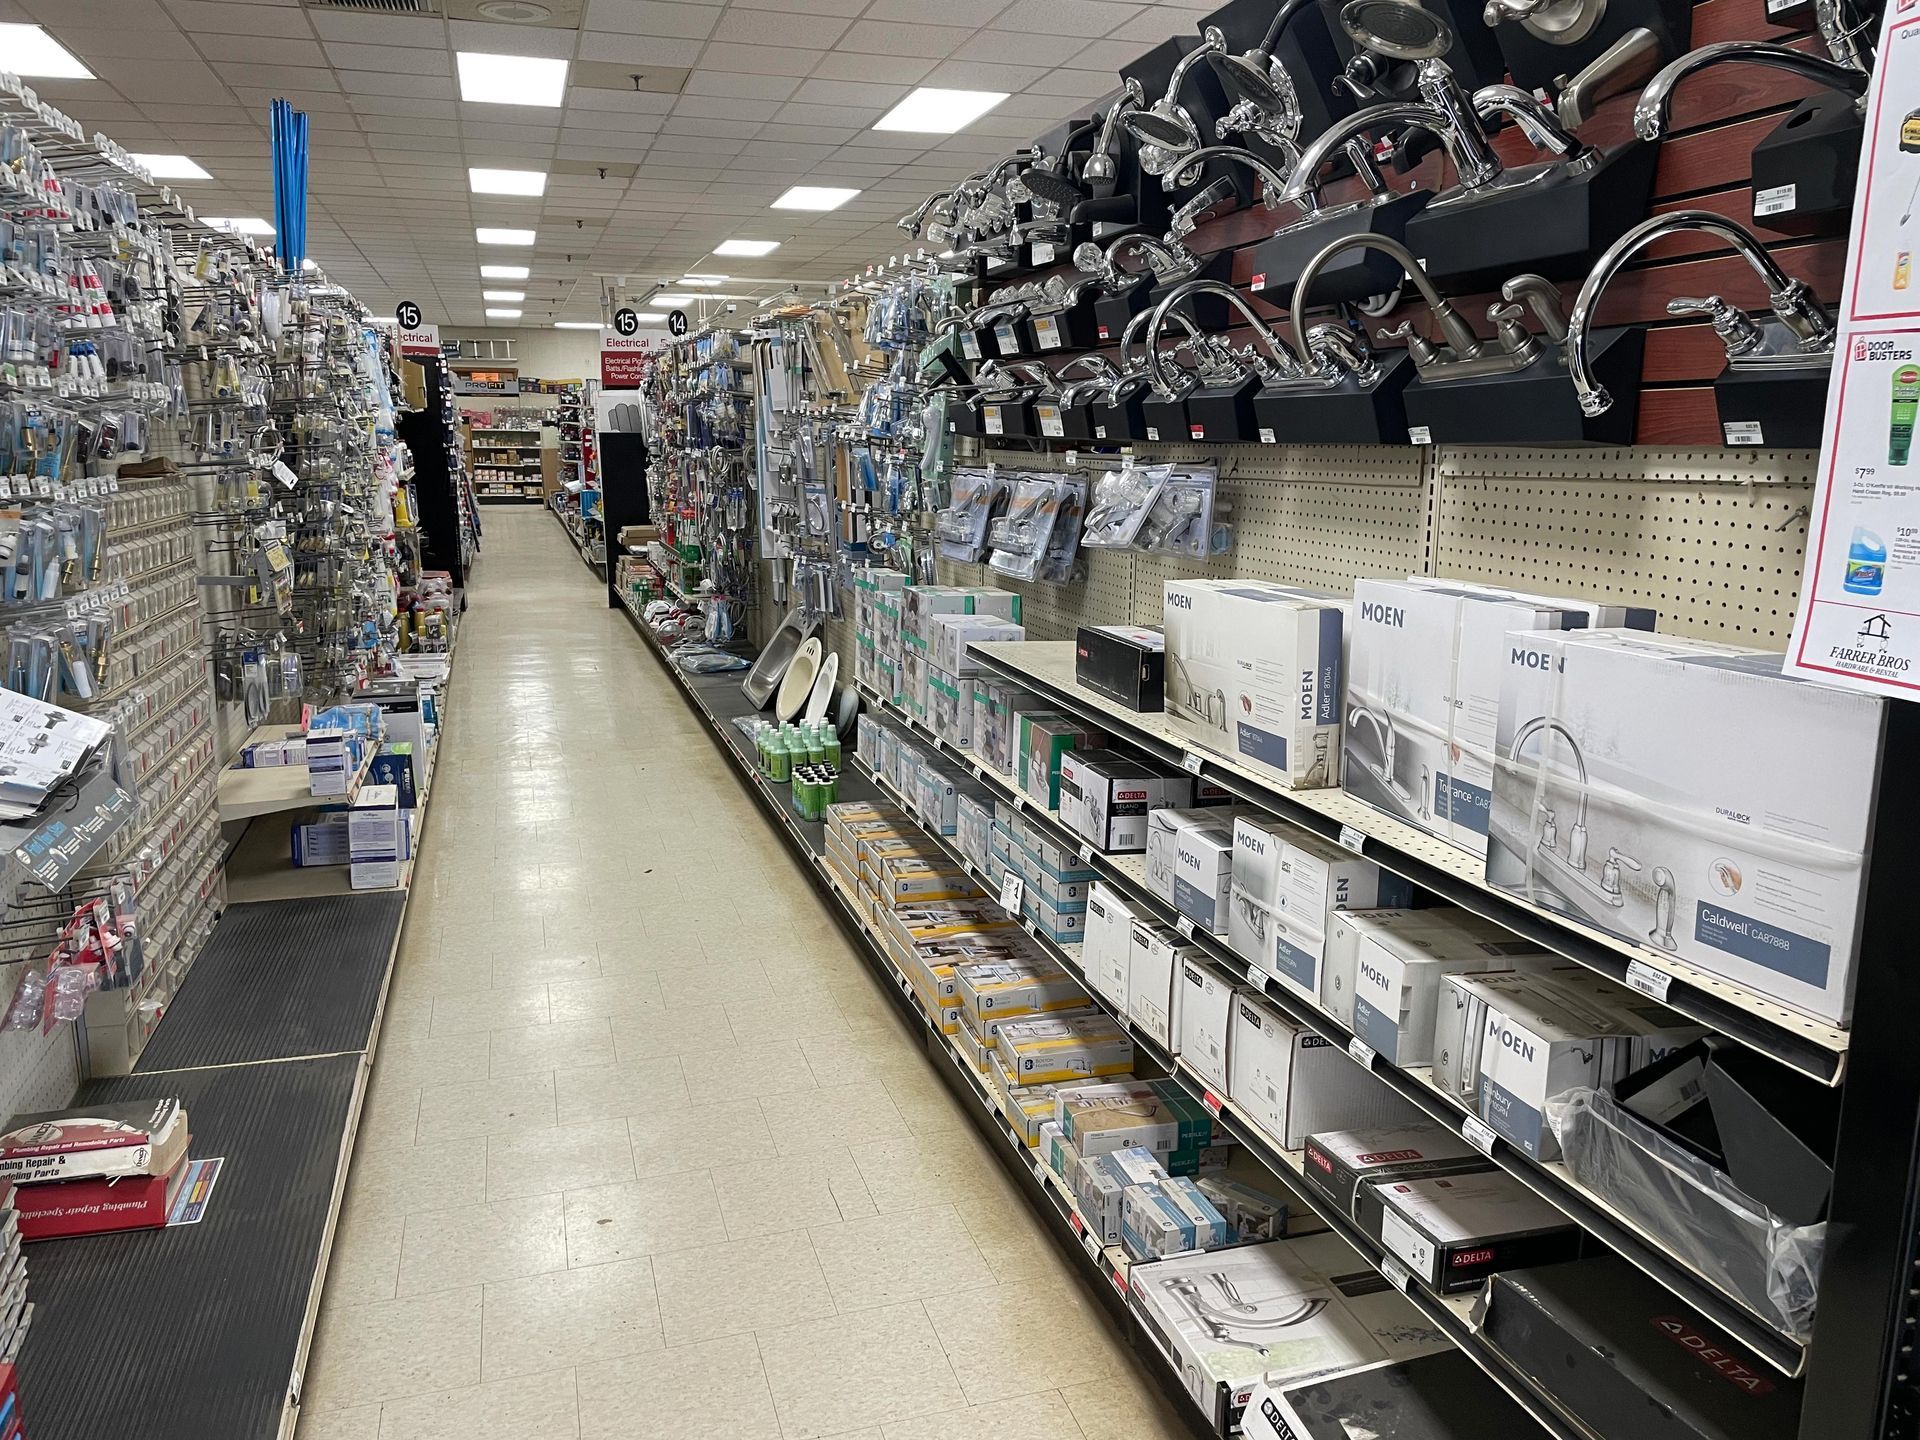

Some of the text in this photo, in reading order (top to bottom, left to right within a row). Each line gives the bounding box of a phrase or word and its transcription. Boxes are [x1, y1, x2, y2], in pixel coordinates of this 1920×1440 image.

[399, 306, 418, 326] 15
[617, 313, 635, 332] 15
[670, 315, 686, 333] 14
[401, 333, 433, 343] ctrical
[606, 338, 649, 347] Electrical
[1868, 341, 1895, 351] DOOR
[1869, 350, 1912, 361] BUSTERS
[610, 372, 629, 380] Power
[1167, 591, 1192, 610] MOEN
[1361, 601, 1404, 628] MOEN
[1511, 648, 1565, 674] MOEN
[1829, 646, 1911, 671] FARRER BROS
[1835, 660, 1869, 673] HARDWARE
[1875, 668, 1899, 679] RENTAL
[1301, 670, 1313, 720] MOEN
[1321, 666, 1332, 719] Adler 87046
[1239, 727, 1252, 738] Adler
[1438, 778, 1472, 803] Torance
[1715, 806, 1751, 822] DURALOCK
[1237, 831, 1265, 856] MOEN
[1178, 847, 1201, 871] MOEN
[1345, 911, 1402, 920] MOEN
[1702, 909, 1749, 936] Caldwell
[1751, 929, 1790, 951] CA87888
[1279, 943, 1292, 955] Adler
[1188, 970, 1202, 987] DELTA
[1361, 961, 1390, 992] MOEN
[1465, 975, 1528, 985] MOEN
[1245, 1008, 1260, 1027] DELTA
[1357, 1001, 1371, 1017] Adler
[1312, 1037, 1332, 1046] DEL
[1489, 1020, 1535, 1063] MOEN
[1484, 1081, 1512, 1110] Bnbury
[73, 1139, 109, 1148] Remodeling
[25, 1157, 56, 1169] Repair
[58, 1155, 66, 1165] &
[1313, 1152, 1332, 1170] DELTA
[1374, 1151, 1419, 1161] DELTA
[34, 1168, 60, 1177] Parts
[66, 1205, 100, 1215] Repair
[102, 1200, 148, 1211] Plumbing
[1463, 1251, 1492, 1264] DELTA
[1680, 1335, 1760, 1390] DELTA
